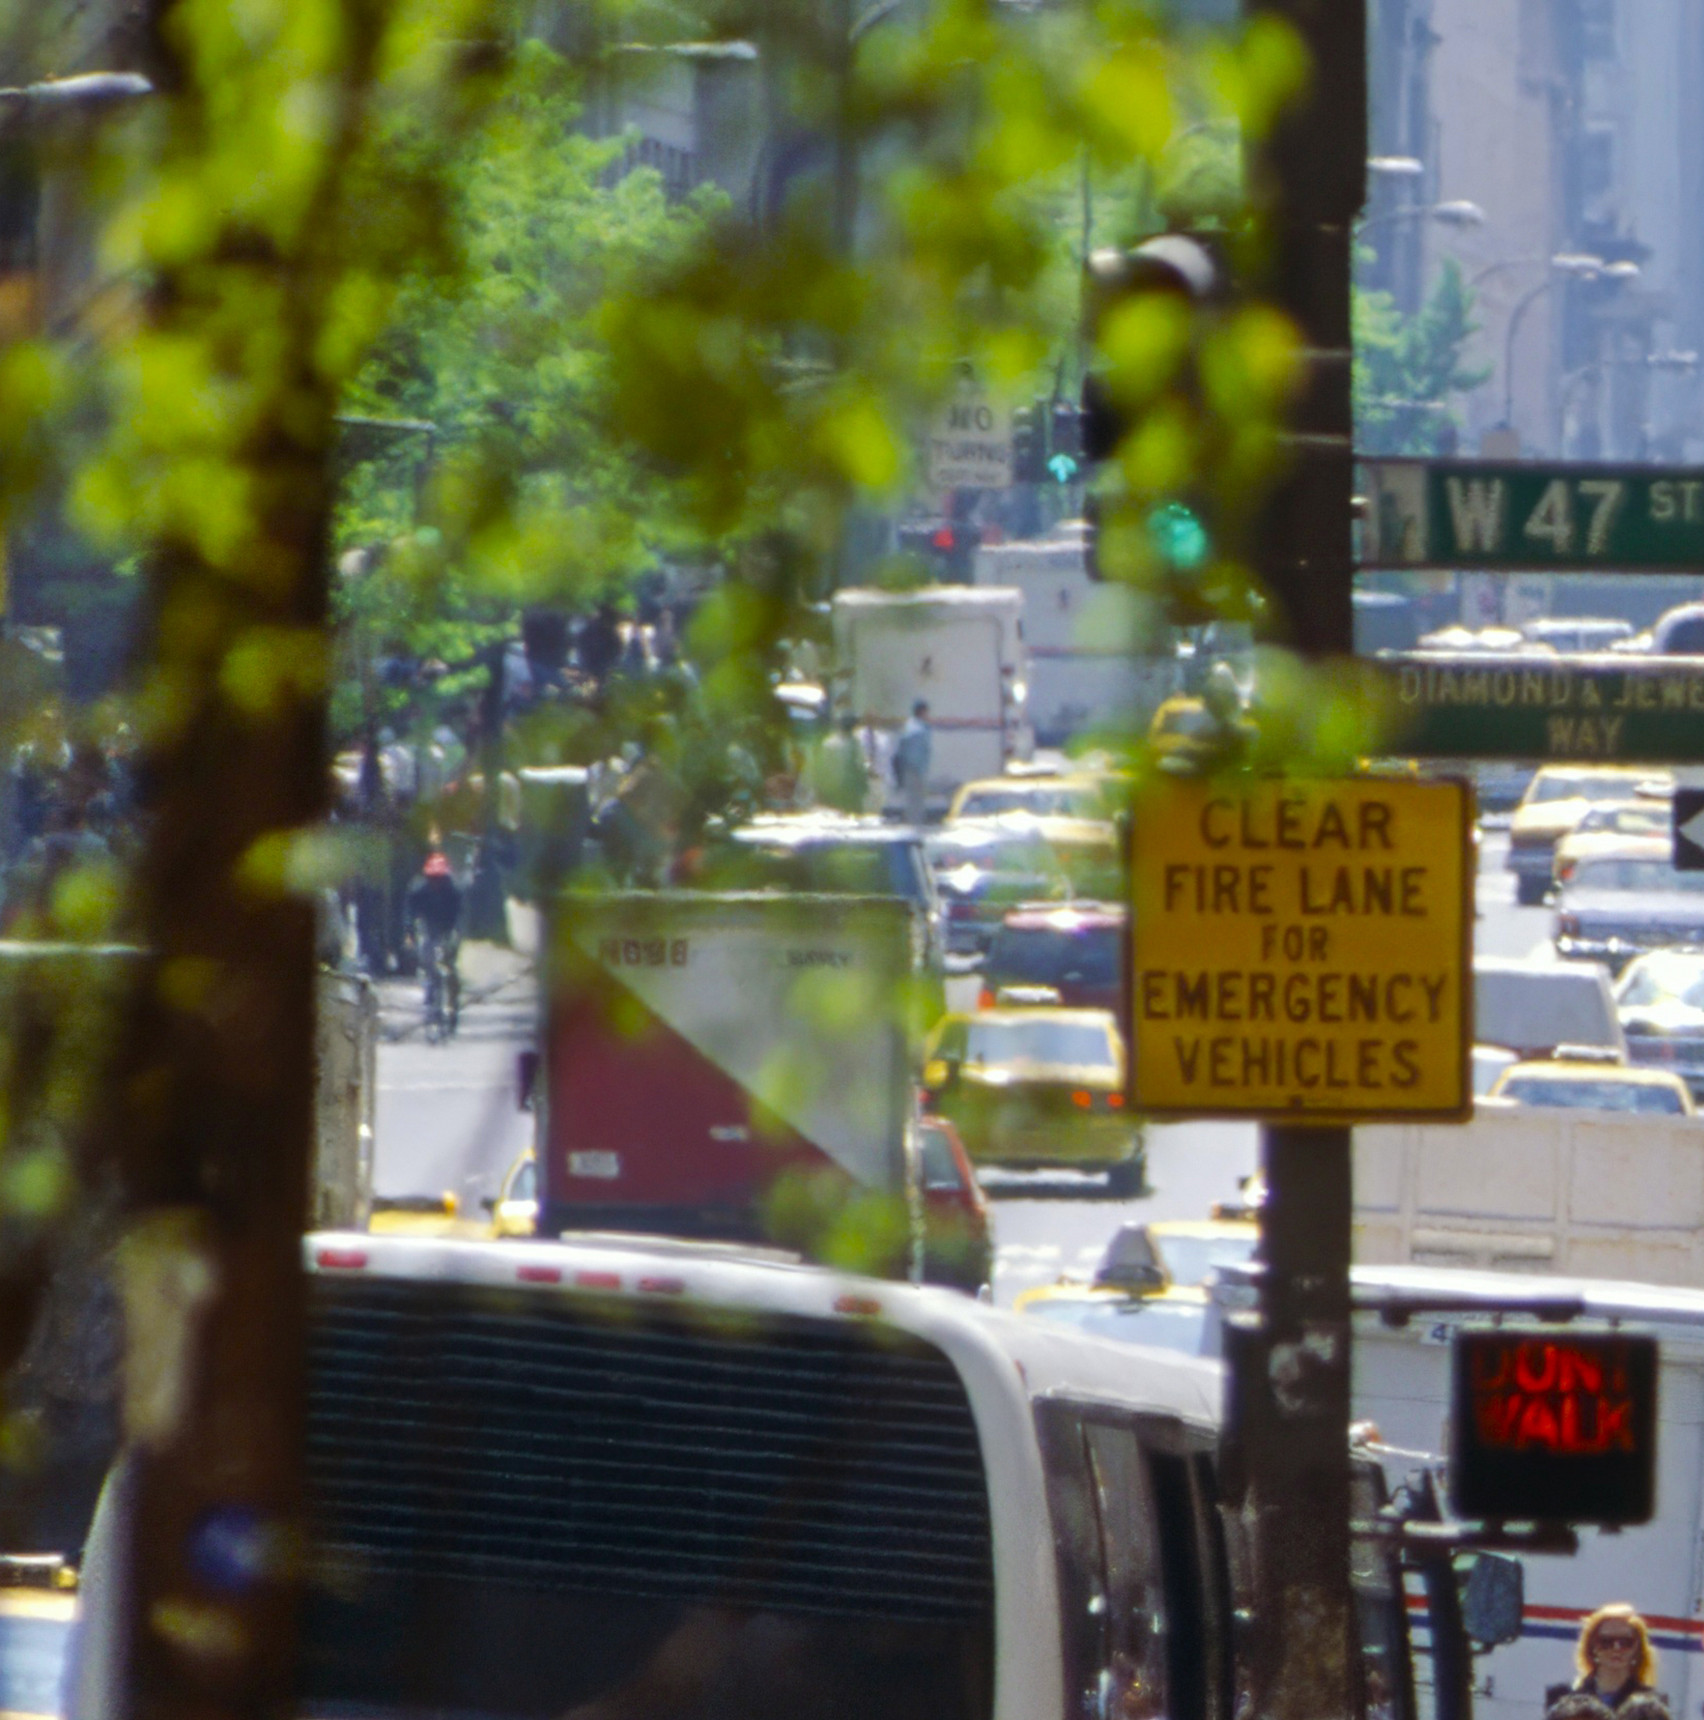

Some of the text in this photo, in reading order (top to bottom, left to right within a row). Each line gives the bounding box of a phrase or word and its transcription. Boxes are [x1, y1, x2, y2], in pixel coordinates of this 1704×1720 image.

[1446, 477, 1703, 554] W 47 ST
[1400, 667, 1573, 706] DIAMOND
[1548, 714, 1625, 755] WAY
[1201, 800, 1395, 851] CLEAR
[1164, 865, 1429, 917] FIRE LANE
[1261, 925, 1329, 963] FOR
[1142, 970, 1450, 1024] EMERGENCY
[1173, 1036, 1422, 1089] VEHICLES
